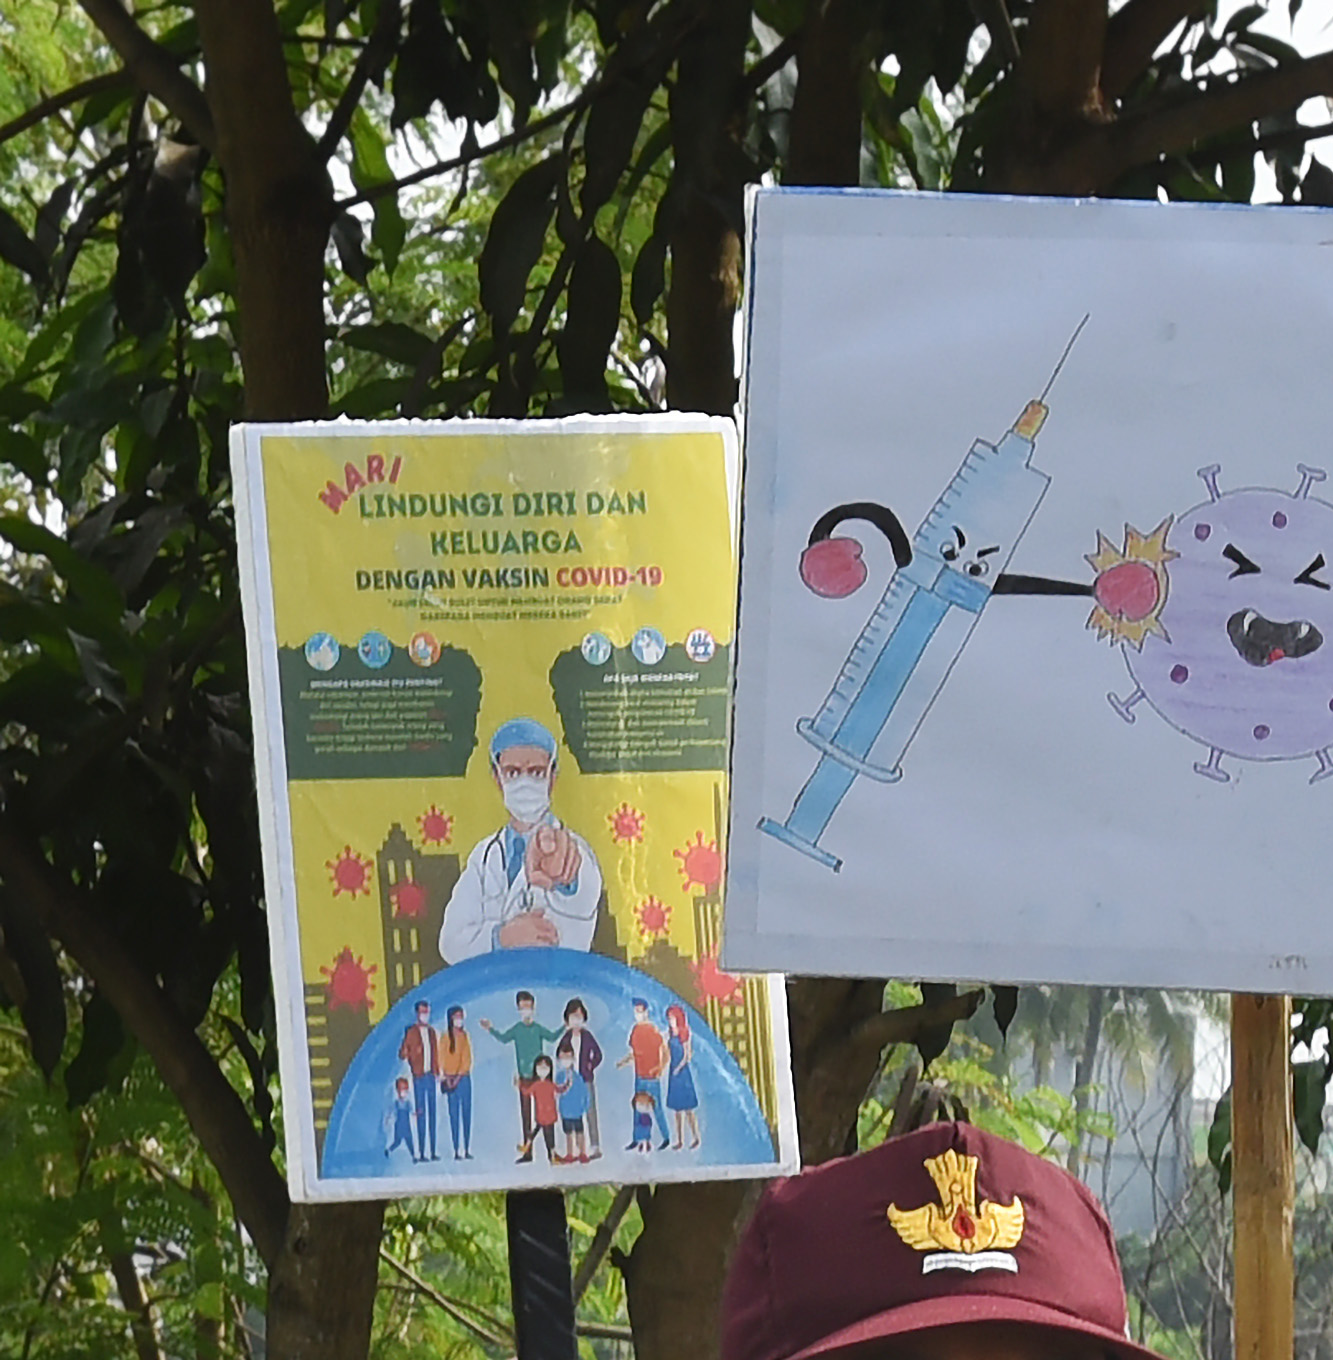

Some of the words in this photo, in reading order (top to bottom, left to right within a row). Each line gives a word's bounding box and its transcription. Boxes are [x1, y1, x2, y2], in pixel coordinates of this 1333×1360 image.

[319, 454, 401, 515] MARI
[359, 492, 503, 519] LINDUNGI
[512, 489, 577, 517] DIRI
[586, 489, 646, 515] DAN
[431, 529, 582, 555] KELUARGA
[356, 568, 456, 591] DENGAN
[462, 566, 550, 589] VAKSIN
[556, 566, 662, 588] COVID-19
